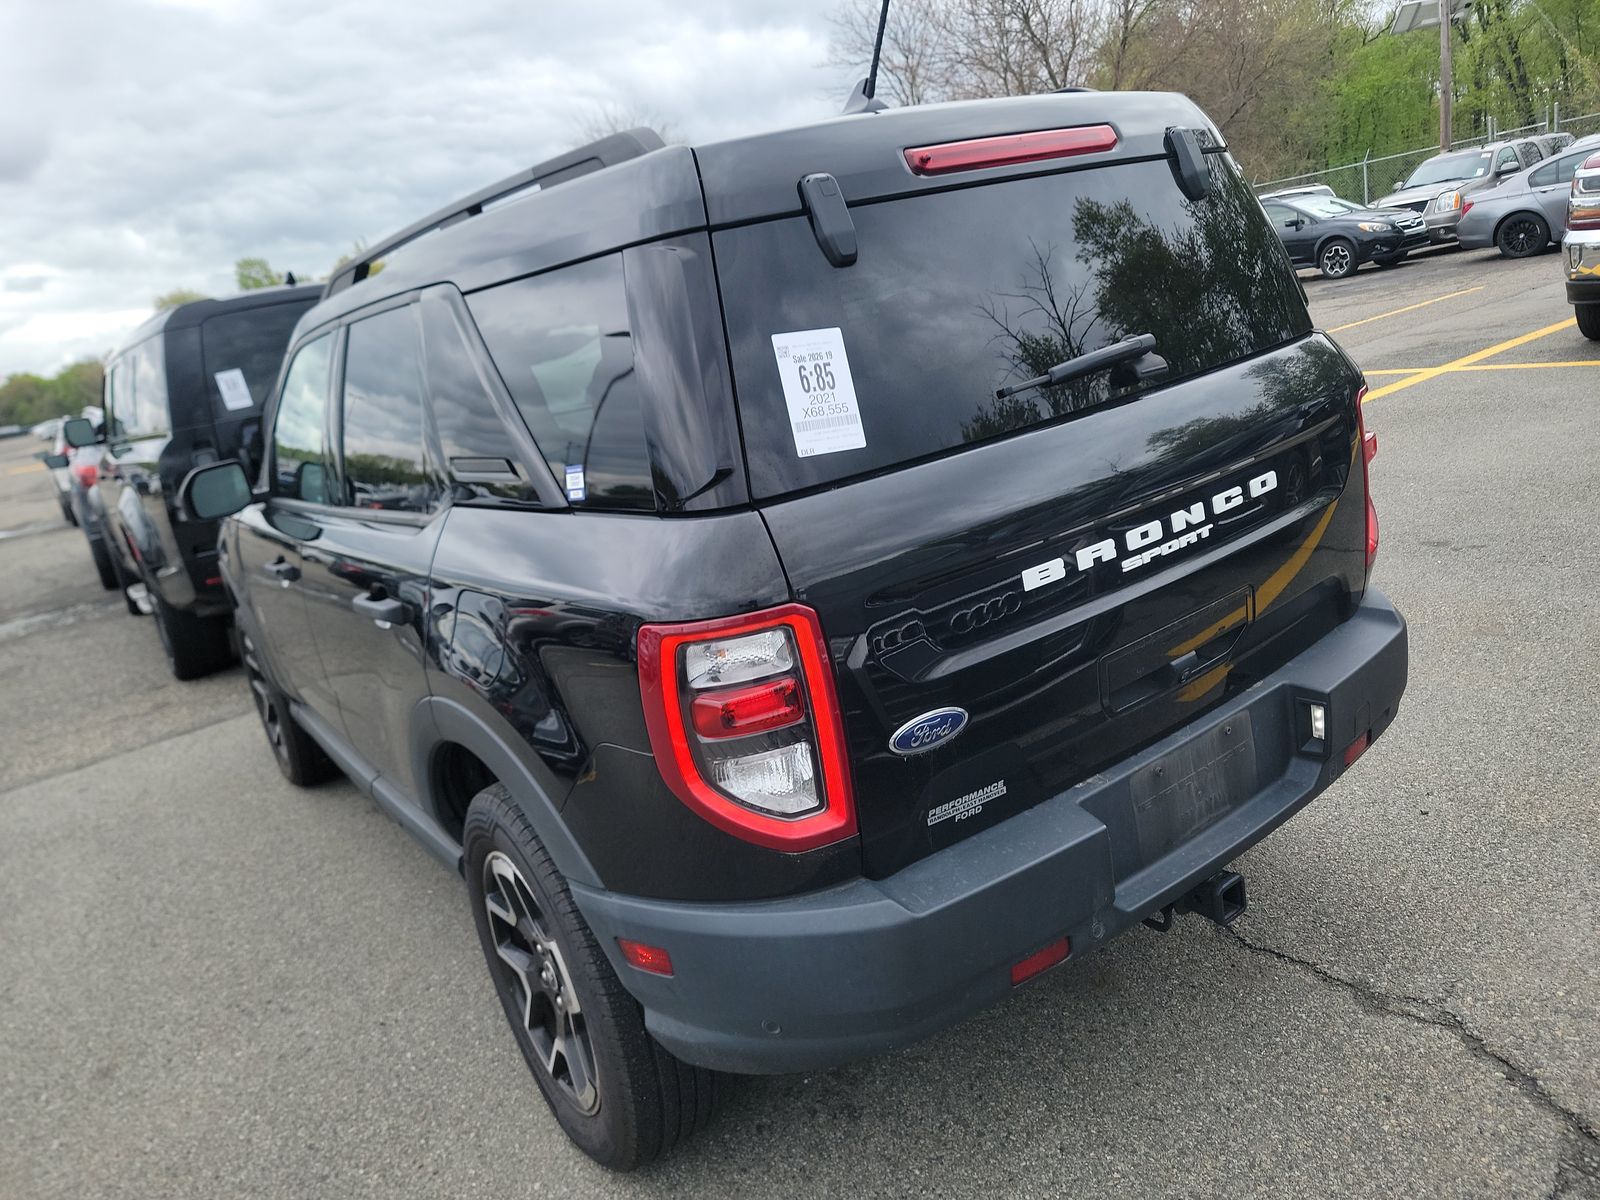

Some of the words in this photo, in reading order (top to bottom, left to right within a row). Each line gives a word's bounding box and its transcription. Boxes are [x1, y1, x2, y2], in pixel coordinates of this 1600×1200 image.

[792, 354, 807, 364] Sale
[808, 351, 824, 362] 2026
[825, 350, 833, 360] 19
[798, 361, 836, 394] 6:85
[802, 402, 849, 419] X68,555
[808, 392, 836, 406] 2021
[1021, 470, 1278, 592] BRONCO
[1121, 523, 1214, 573] SPORT
[910, 717, 952, 748] Ford
[928, 779, 1005, 818] PERFORMANCE
[955, 805, 983, 822] FORD
